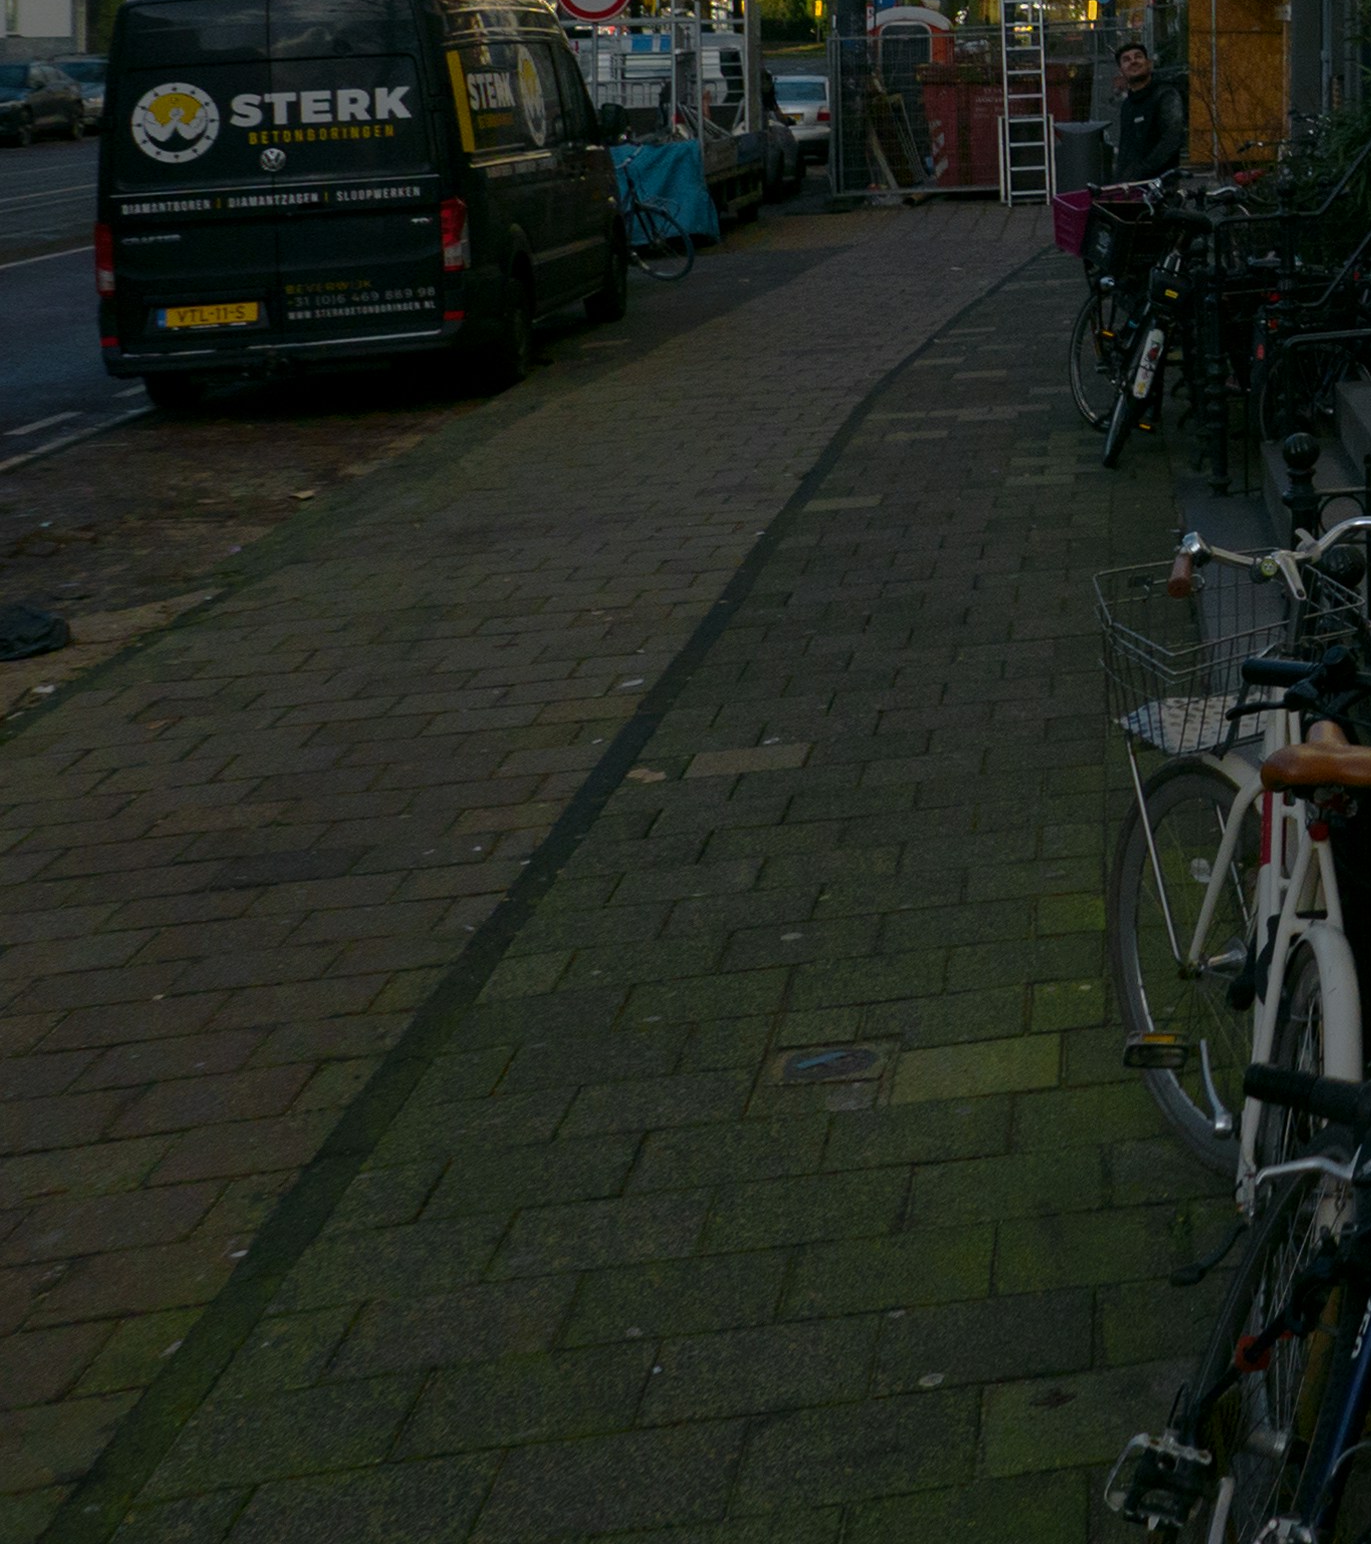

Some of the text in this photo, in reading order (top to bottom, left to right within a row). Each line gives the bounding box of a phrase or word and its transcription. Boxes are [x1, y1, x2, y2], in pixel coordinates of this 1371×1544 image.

[229, 85, 412, 128] STERK
[248, 124, 395, 146] BETONBORINGEN
[336, 186, 421, 203] SLOOPWERKEN
[416, 285, 436, 298] 98
[176, 305, 246, 323] VTL-11-S
